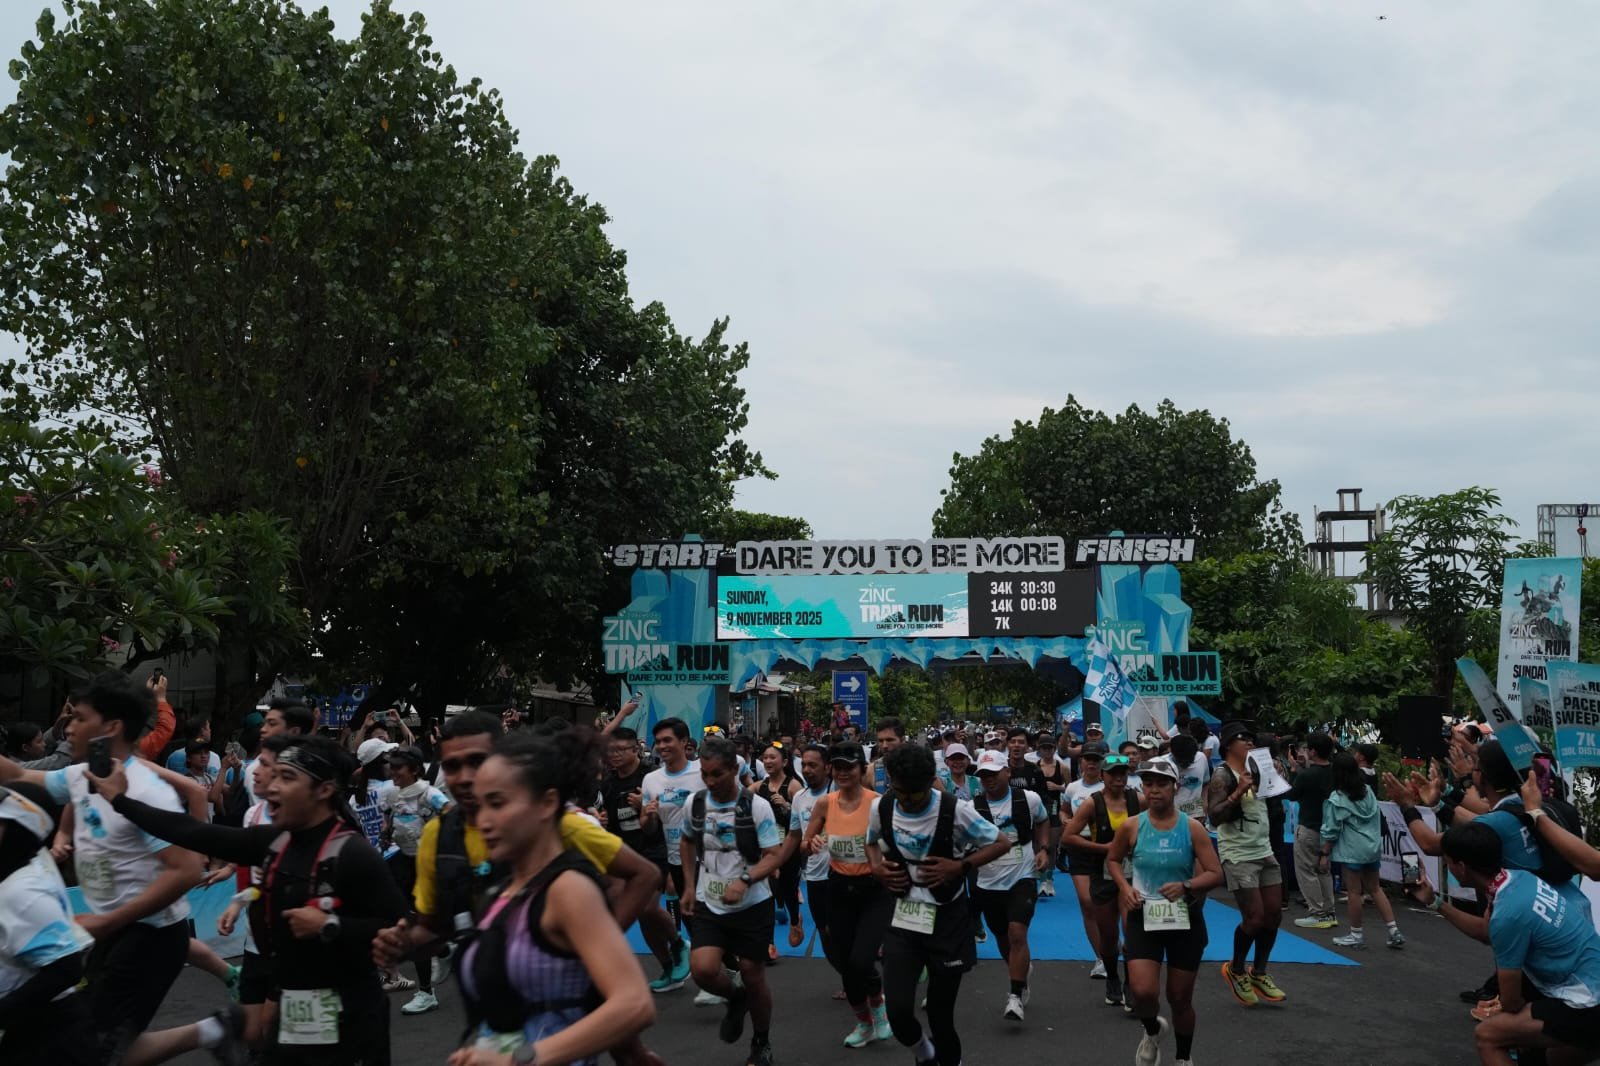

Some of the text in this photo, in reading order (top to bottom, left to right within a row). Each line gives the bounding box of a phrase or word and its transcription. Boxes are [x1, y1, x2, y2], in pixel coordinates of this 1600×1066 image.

[612, 543, 724, 567] START
[741, 542, 1059, 570] DARE YOU TO BE MORE
[1075, 538, 1195, 562] FINISH
[858, 587, 896, 603] ZINC
[990, 580, 1056, 595] 34K 30:30
[726, 590, 769, 606] SUNDAY,
[990, 597, 1057, 612] 14K 00:08
[726, 611, 823, 626] 9 NOVEMBER 2025
[859, 603, 944, 623] TRAIL RUN
[602, 619, 659, 641] ZINC
[994, 616, 1010, 630] 7K
[1511, 624, 1538, 638] ZINC
[1085, 628, 1143, 651] ZINC
[1544, 639, 1571, 656] RUN
[603, 643, 730, 671] TRAIL RUN
[1161, 654, 1218, 682] RUN
[628, 673, 729, 682] DARE YOU TO BE MORE
[1140, 683, 1218, 692] YOU TO BE MORE
[1576, 731, 1596, 747] 7K
[832, 840, 854, 853] 4073
[1383, 829, 1407, 857] INC
[898, 900, 921, 917] 4204
[1147, 903, 1175, 918] 4071
